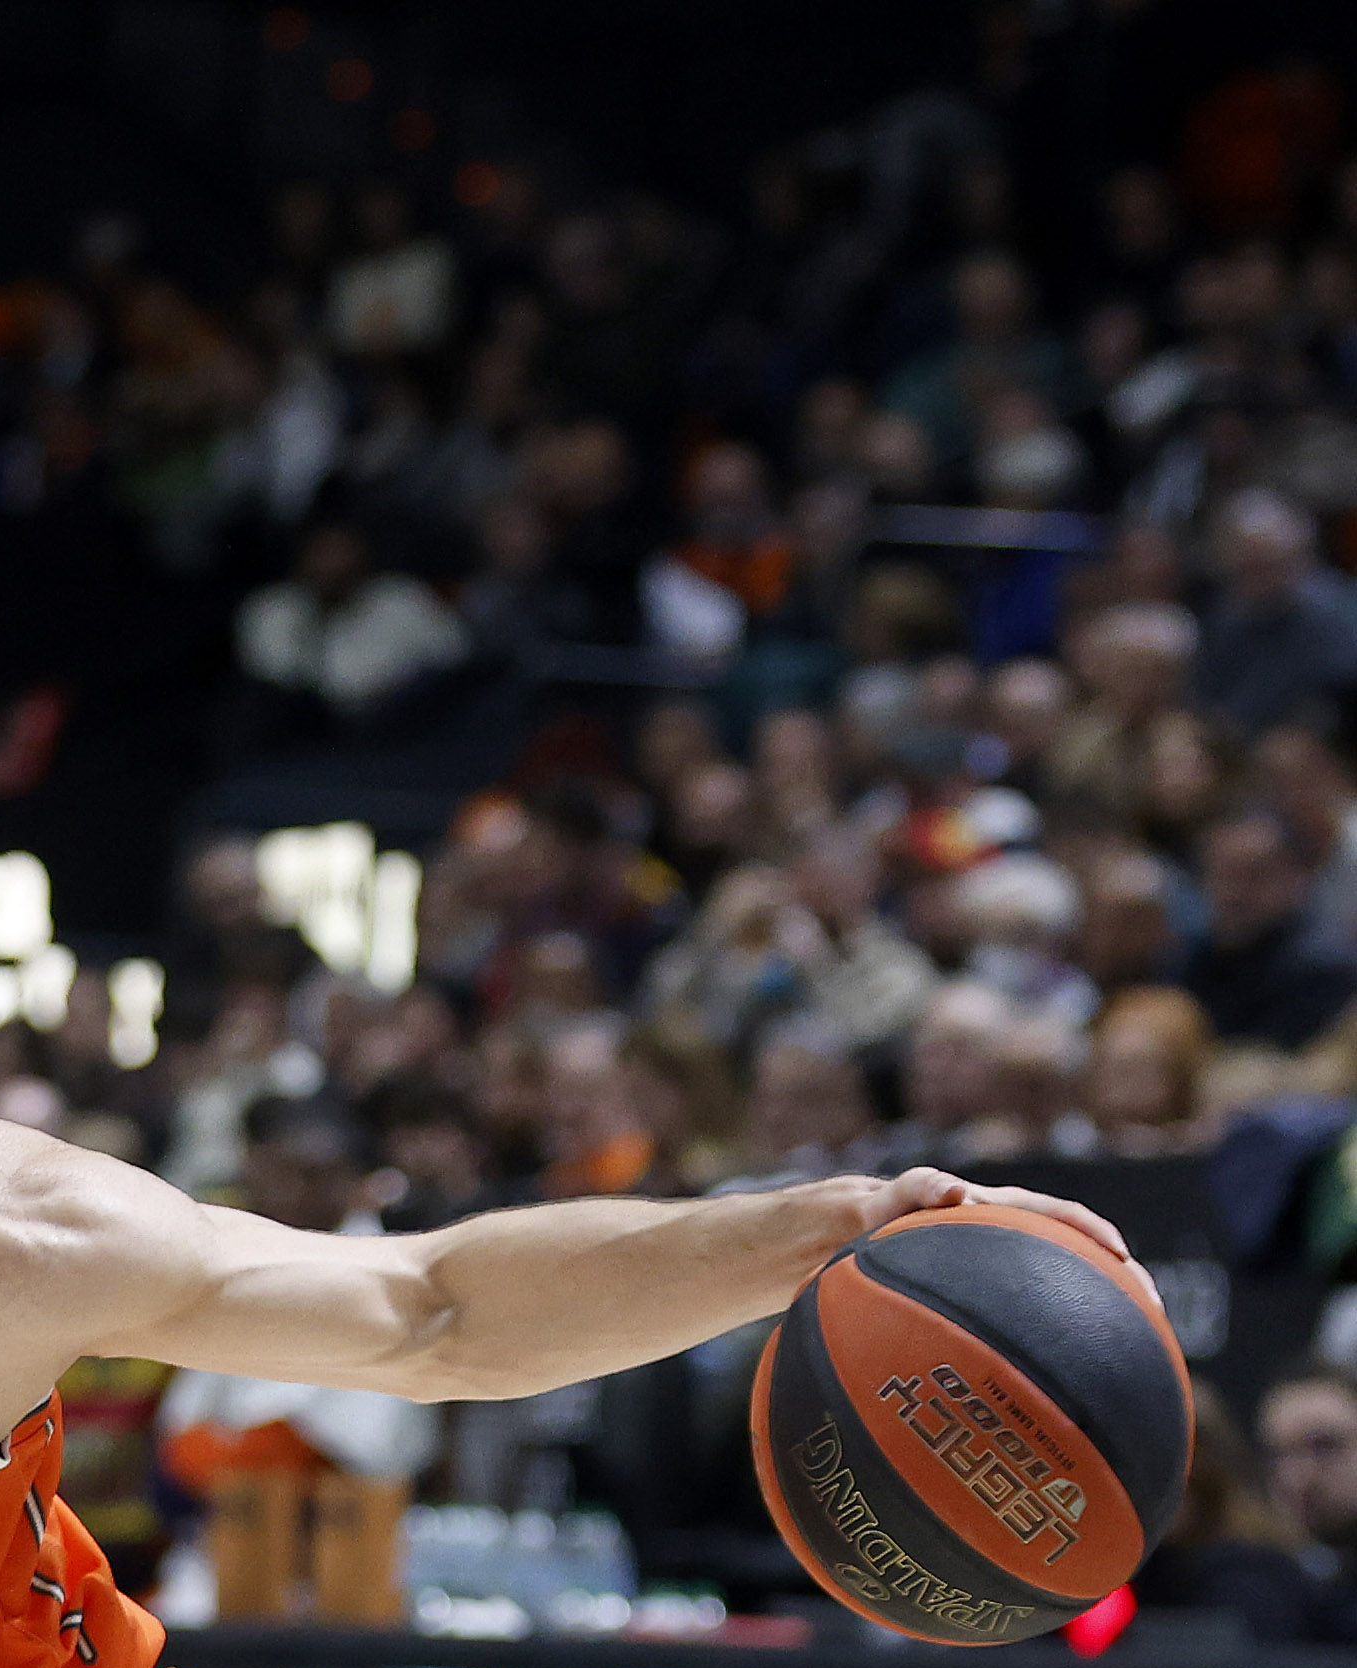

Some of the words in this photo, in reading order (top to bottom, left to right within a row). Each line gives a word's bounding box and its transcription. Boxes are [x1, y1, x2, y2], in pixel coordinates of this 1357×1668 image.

[878, 1374, 1080, 1566] LEGACY
[929, 1363, 1054, 1482] 1000
[790, 1412, 1036, 1634] SPALDING
